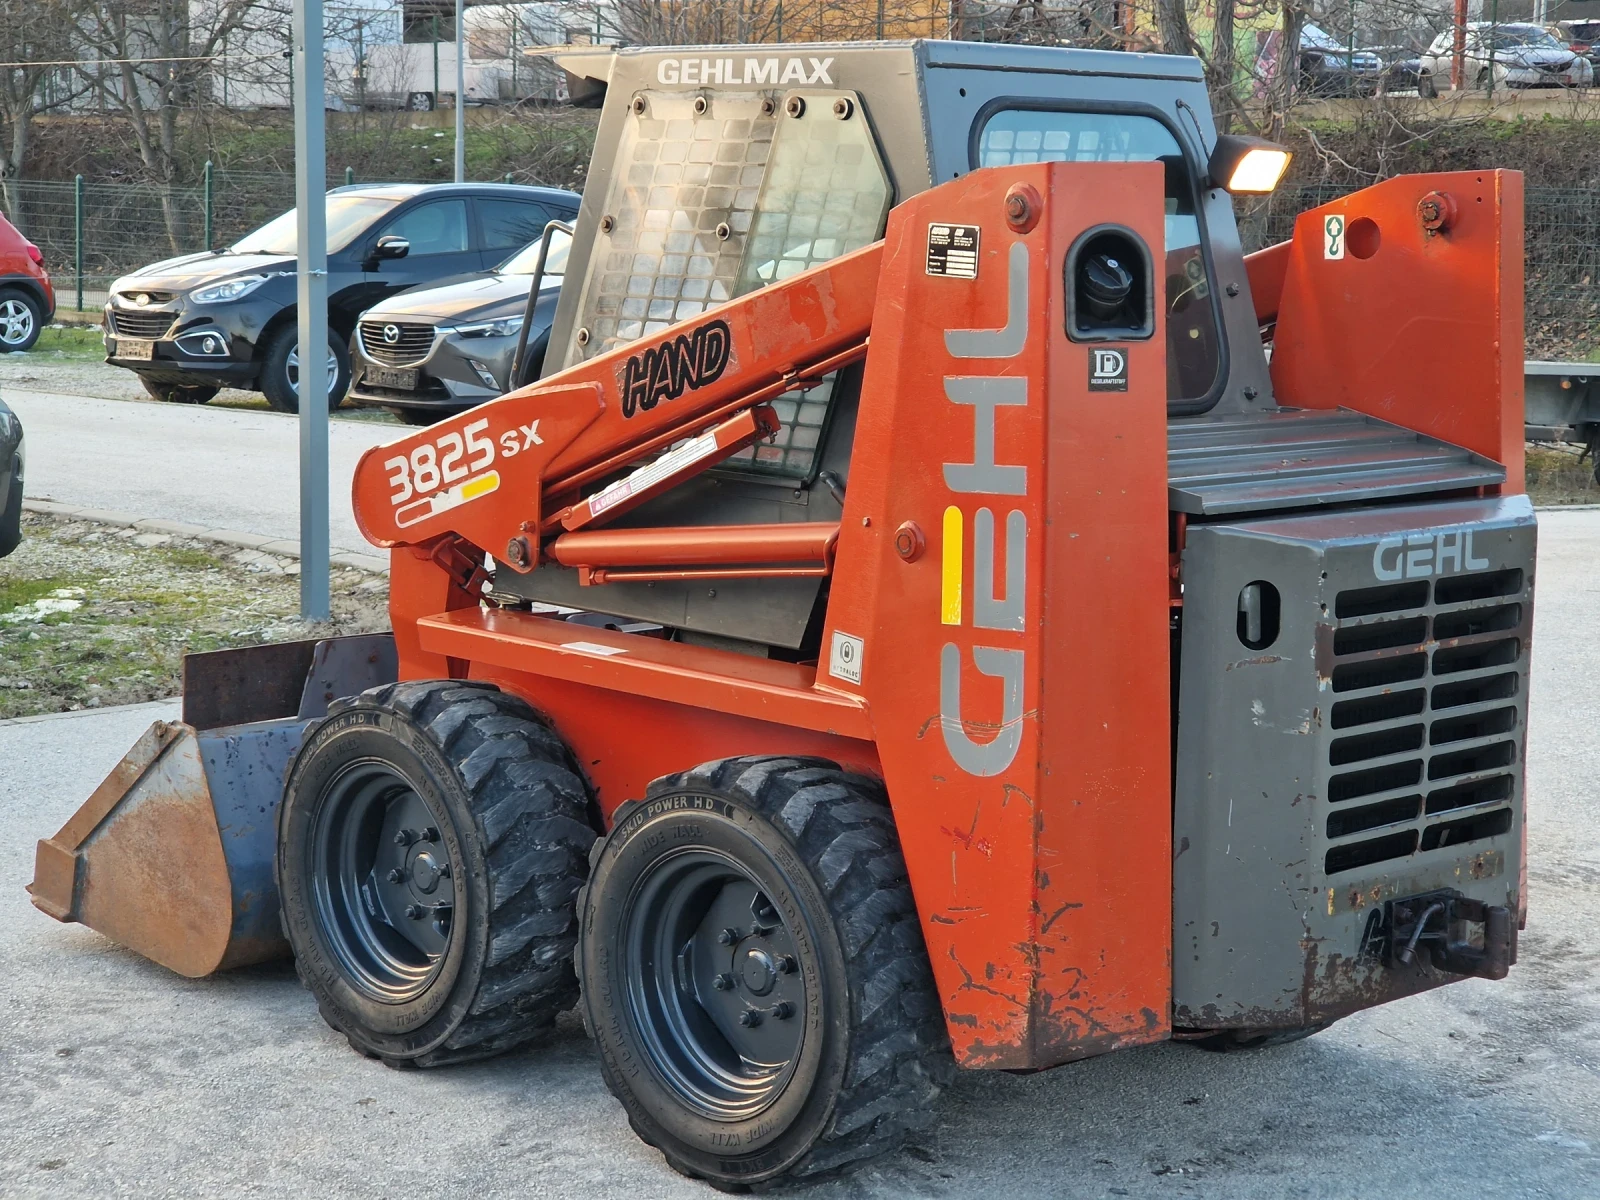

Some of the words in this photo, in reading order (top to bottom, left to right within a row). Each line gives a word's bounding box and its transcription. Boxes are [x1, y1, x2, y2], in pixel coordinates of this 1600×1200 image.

[657, 57, 835, 85] GEHLMAX
[622, 319, 731, 418] HAND
[384, 417, 496, 506] 3825
[601, 486, 629, 508] GEFAHR
[940, 240, 1030, 777] GEHL
[1372, 528, 1490, 582] GEHL
[315, 718, 346, 746] POWER
[621, 813, 644, 838] SKID
[647, 796, 688, 818] POWER
